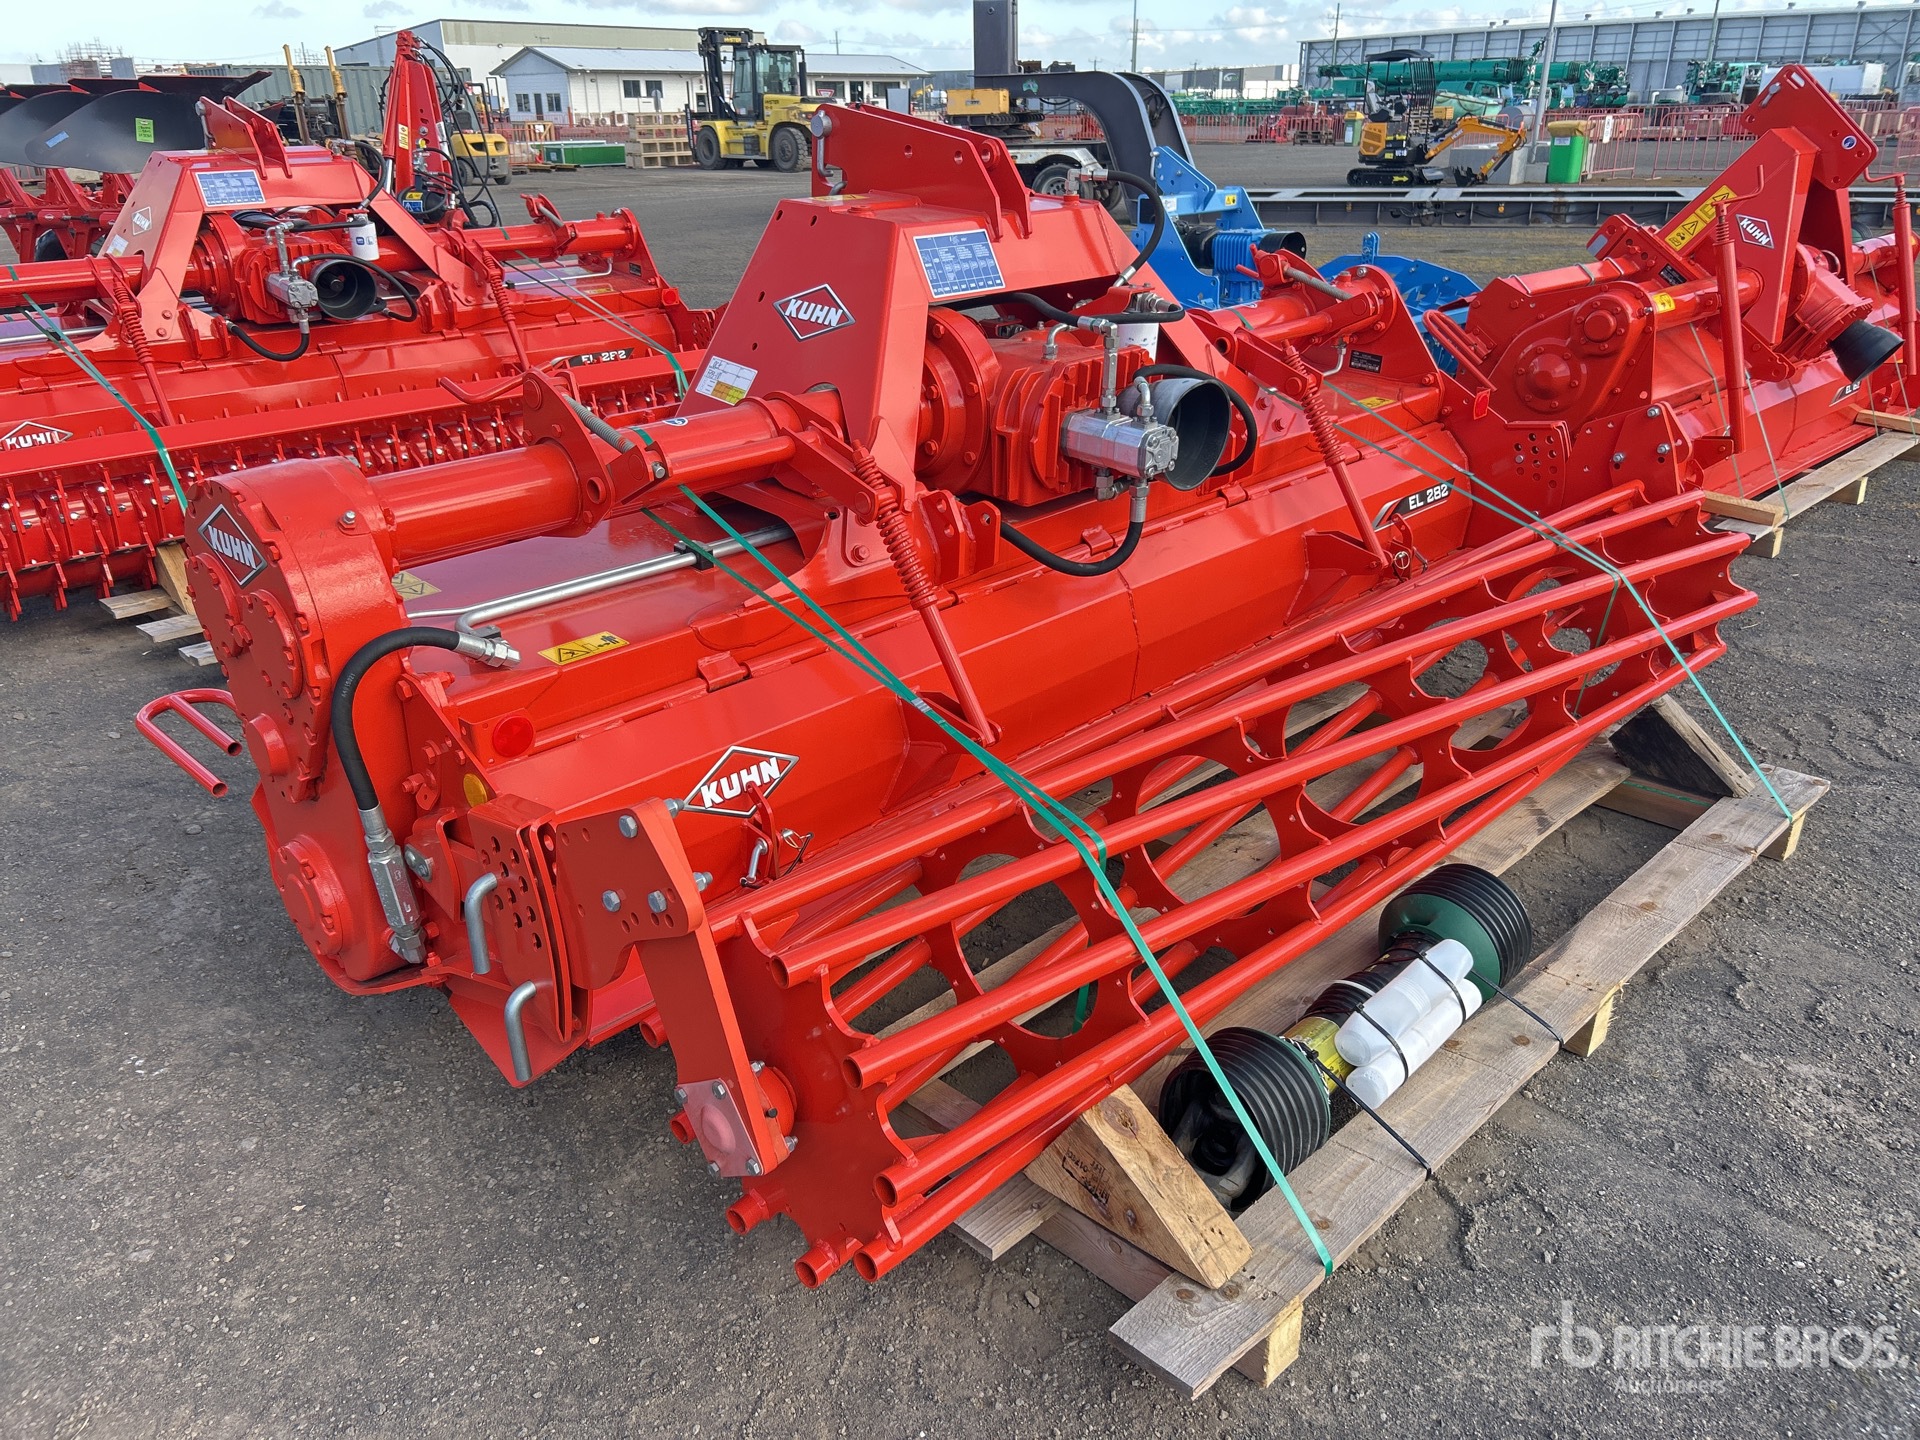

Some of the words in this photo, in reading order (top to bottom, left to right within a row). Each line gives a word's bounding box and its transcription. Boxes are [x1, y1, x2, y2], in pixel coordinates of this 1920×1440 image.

[1740, 218, 1770, 245] KUHN
[785, 298, 844, 327] KUHN
[601, 350, 627, 362] 282
[5, 430, 60, 450] KUHN
[1408, 493, 1424, 511] EL
[1426, 483, 1449, 503] 282
[207, 525, 257, 570] KUHN
[700, 756, 781, 809] KUHN
